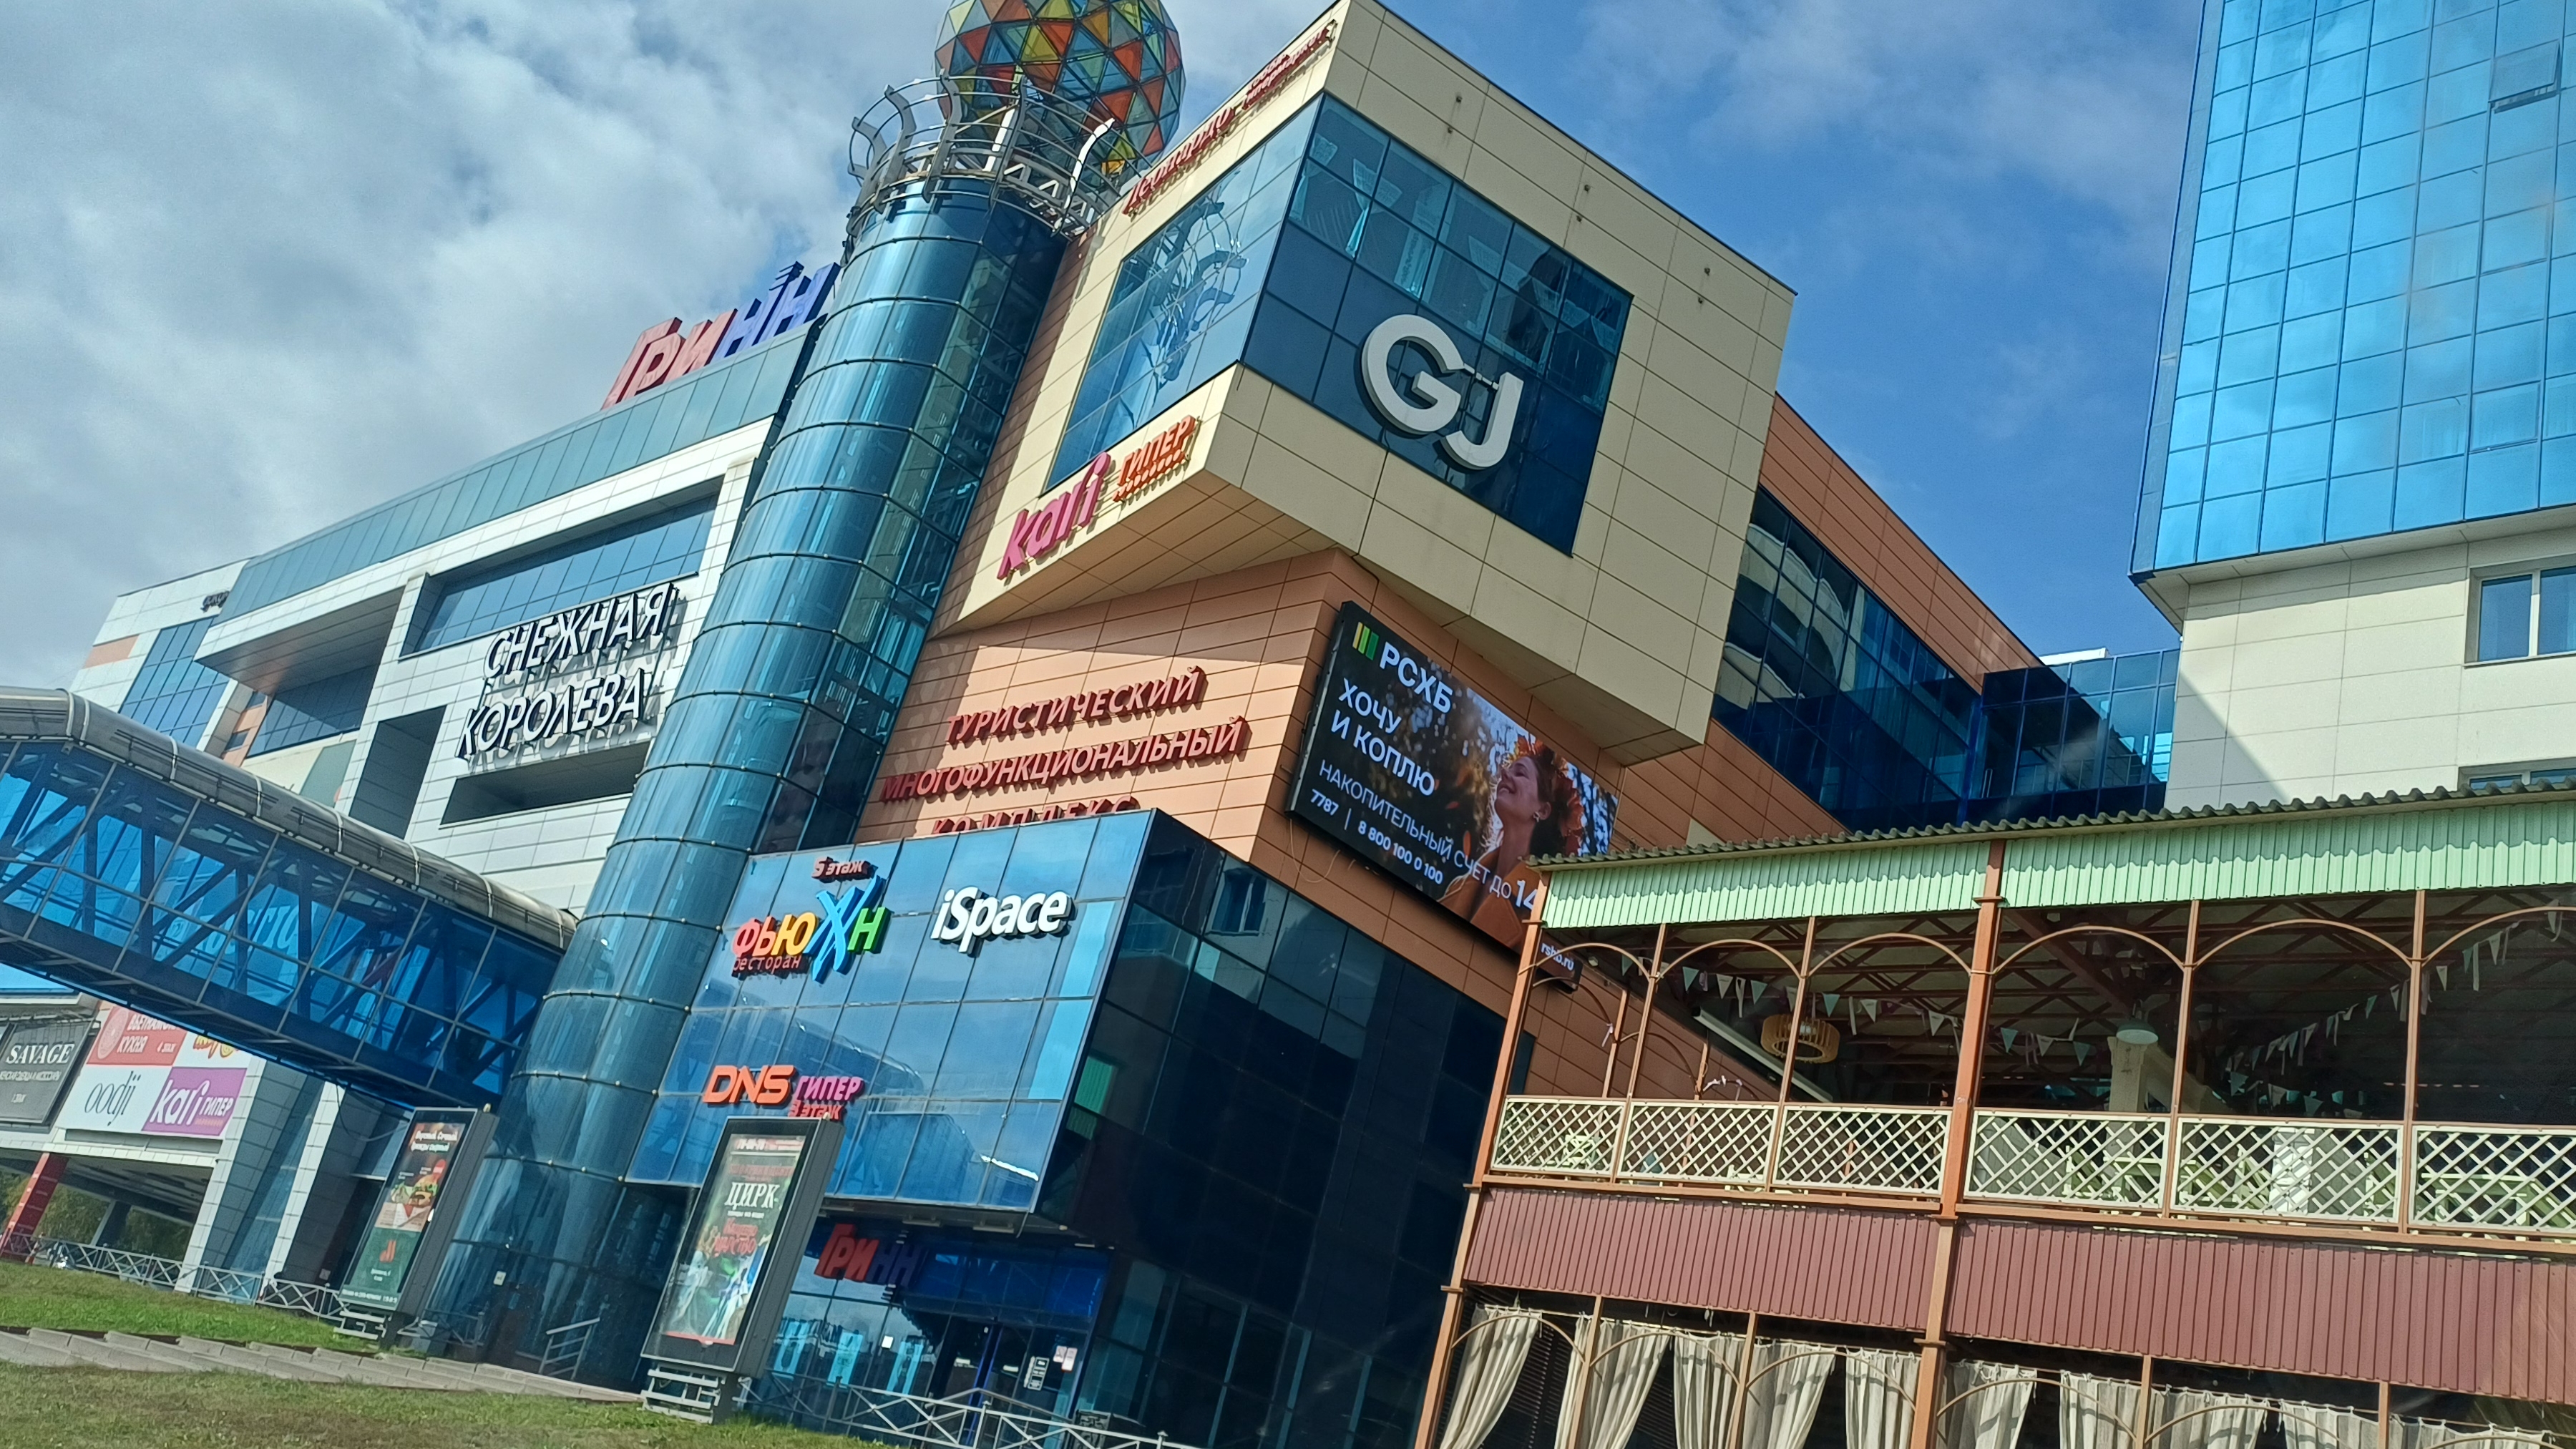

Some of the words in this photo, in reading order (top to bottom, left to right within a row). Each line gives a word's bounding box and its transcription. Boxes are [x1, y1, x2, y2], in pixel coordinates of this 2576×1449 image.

[601, 261, 841, 411] ГРИНН
[1362, 313, 1524, 470] GJ
[997, 451, 1111, 580] kari
[1118, 414, 1196, 486] ГИПЕР
[484, 582, 678, 679] СНЕЖНАЯ
[945, 665, 1207, 745] ТУРИСТИЧЕСКИЙ
[1338, 677, 1402, 733] ХОЧУ
[1380, 641, 1453, 713] РСХБ
[455, 668, 645, 758] КОРОЛЕВА
[880, 716, 1251, 803] МНОГОФУНКЦИОНАЛЬНЫЙ
[1331, 709, 1350, 740] И
[1353, 724, 1435, 796] КОПЛЮ
[1309, 789, 1340, 816] 7787
[1357, 820, 1366, 835] 8
[1367, 826, 1391, 850] 800
[1392, 842, 1413, 864] 100
[1414, 857, 1423, 871] 0
[1424, 863, 1444, 885] 100
[1319, 759, 1455, 861] НАКОПИТЕЛЬНЫЙ
[1453, 850, 1491, 884] СЧЕТ
[1489, 877, 1512, 899] ДО
[811, 857, 827, 877] 5
[825, 860, 866, 877] этаж
[931, 886, 1073, 953] iSpace
[733, 955, 802, 975] ресторан
[1541, 943, 1574, 971] rshb.ru
[6, 1044, 74, 1064] SAVAGE
[117, 1035, 148, 1053] КУХНЯ
[84, 1070, 142, 1127] oodji
[150, 1079, 210, 1126] kari
[199, 1096, 234, 1116] ГИПЕР
[702, 1065, 796, 1106] DNS
[795, 1075, 862, 1101] ГИПЕР
[724, 1181, 780, 1210] ЦИРК
[814, 1224, 924, 1287] ГРИНН
